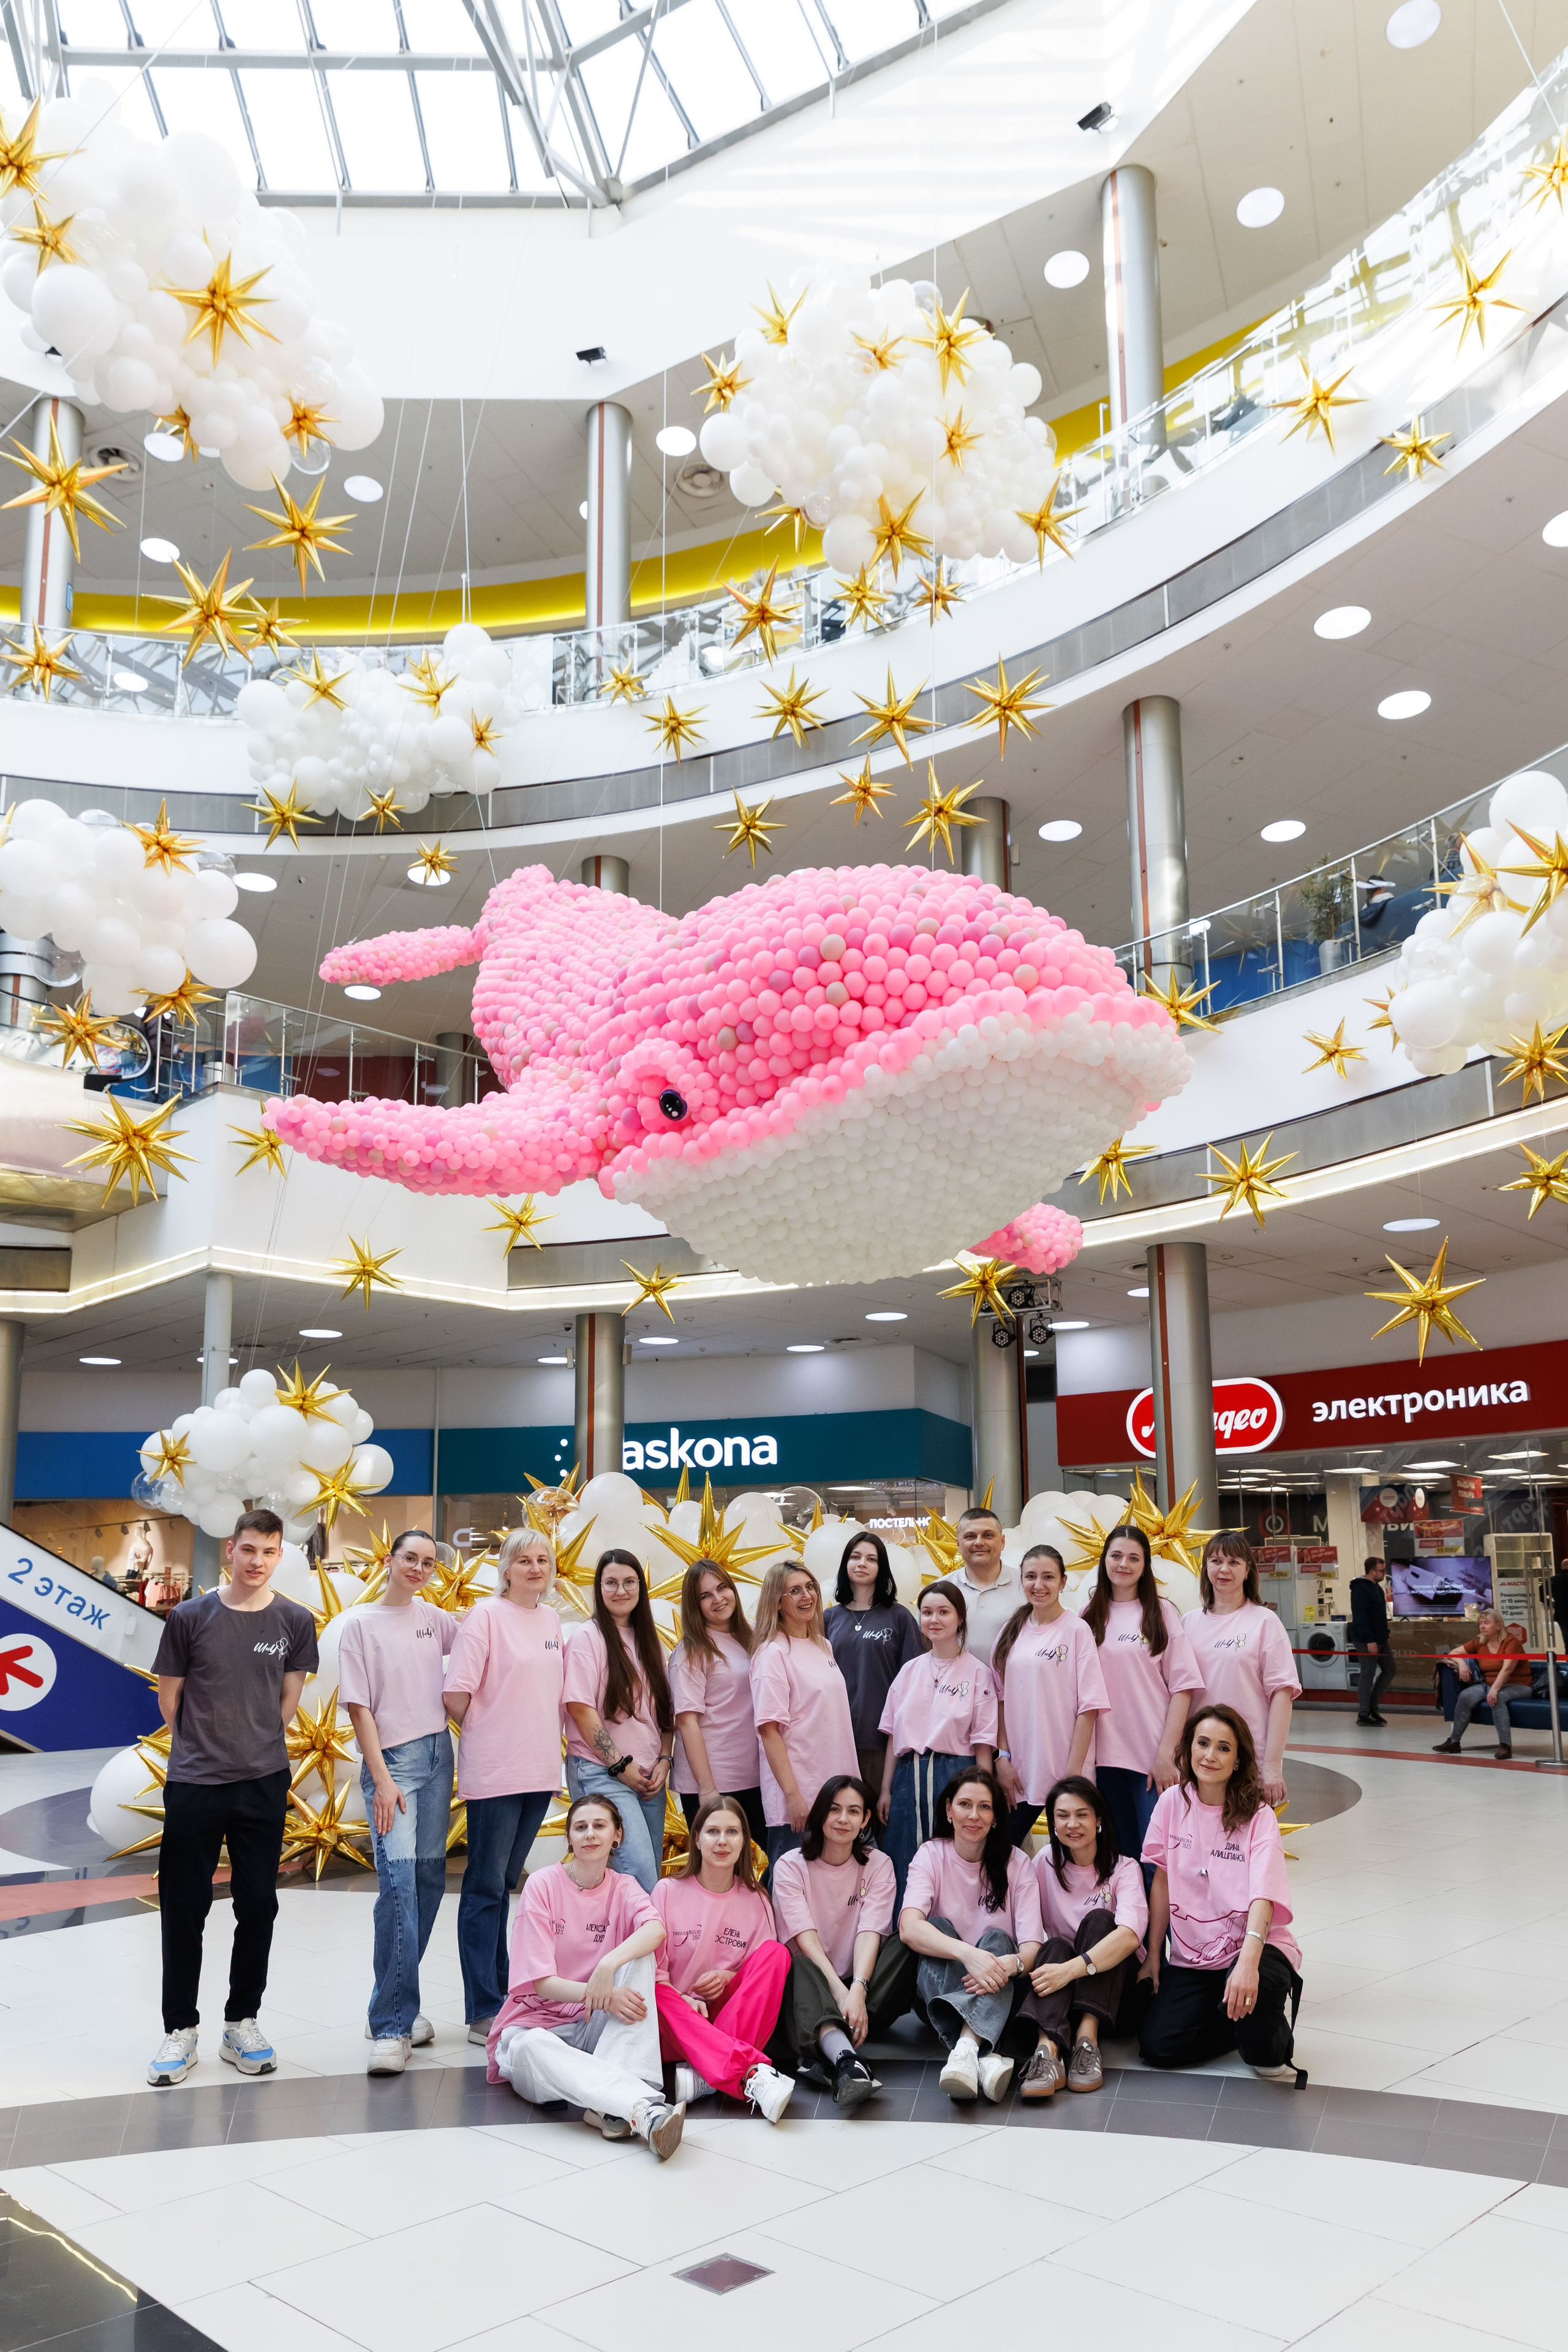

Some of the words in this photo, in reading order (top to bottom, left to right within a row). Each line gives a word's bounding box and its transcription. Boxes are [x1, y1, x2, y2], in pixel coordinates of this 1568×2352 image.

[1312, 1381, 1529, 1423] электроника
[623, 1427, 777, 1470] askona
[869, 1516, 932, 1529] ПОСТЕЛЬНО
[7, 1558, 33, 1585] 2
[34, 1577, 111, 1630] этаж
[1224, 1842, 1240, 1852] ДИНА
[723, 1928, 740, 1938] ЕЛЕНА
